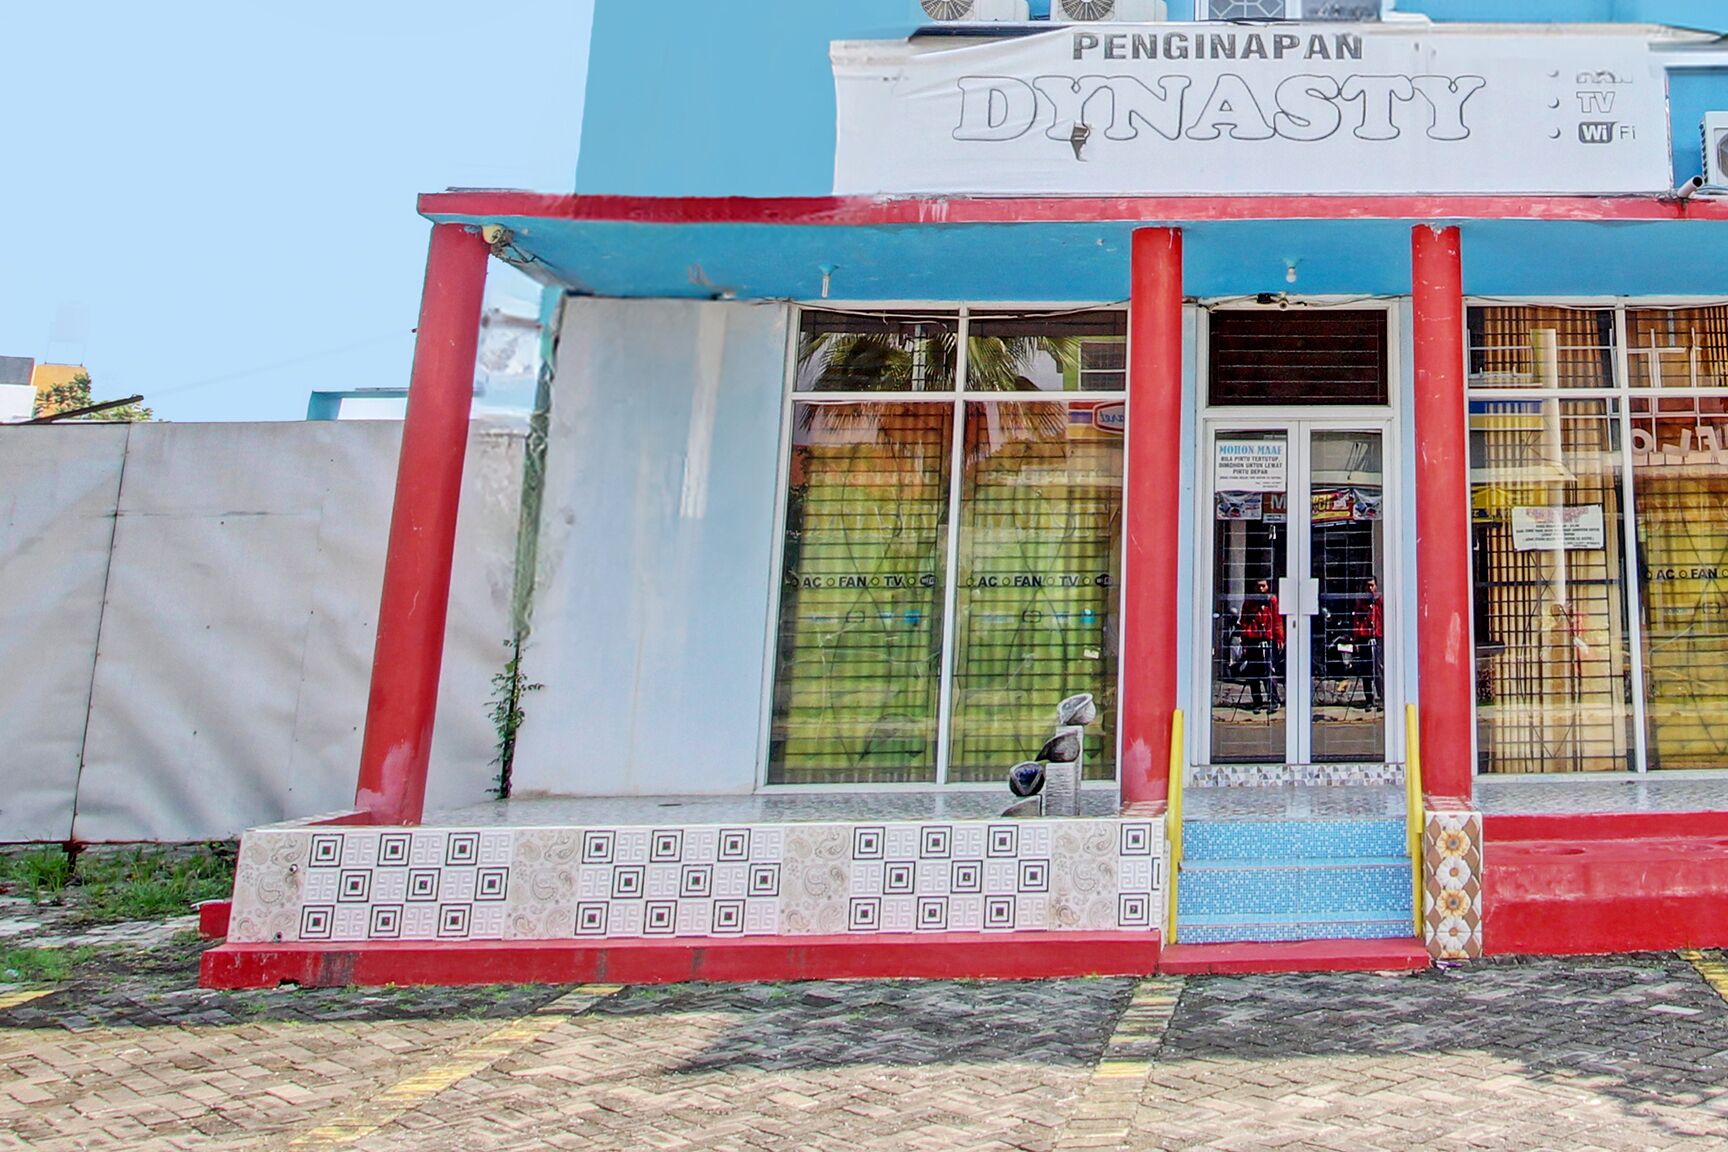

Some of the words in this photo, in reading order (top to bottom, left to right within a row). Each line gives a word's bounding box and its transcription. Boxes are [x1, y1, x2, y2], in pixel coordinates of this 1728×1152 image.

[1071, 32, 1365, 62] PENGINAPAN
[951, 73, 1487, 142] DYNASTY
[1576, 91, 1616, 114] TV
[802, 576, 822, 588] AC
[838, 575, 868, 588] FAN
[884, 575, 904, 587] TV
[978, 576, 998, 588] AC
[1014, 576, 1042, 588] FAN
[1058, 575, 1079, 587] TV
[1656, 568, 1675, 580] AC
[1691, 567, 1718, 579] FAN
